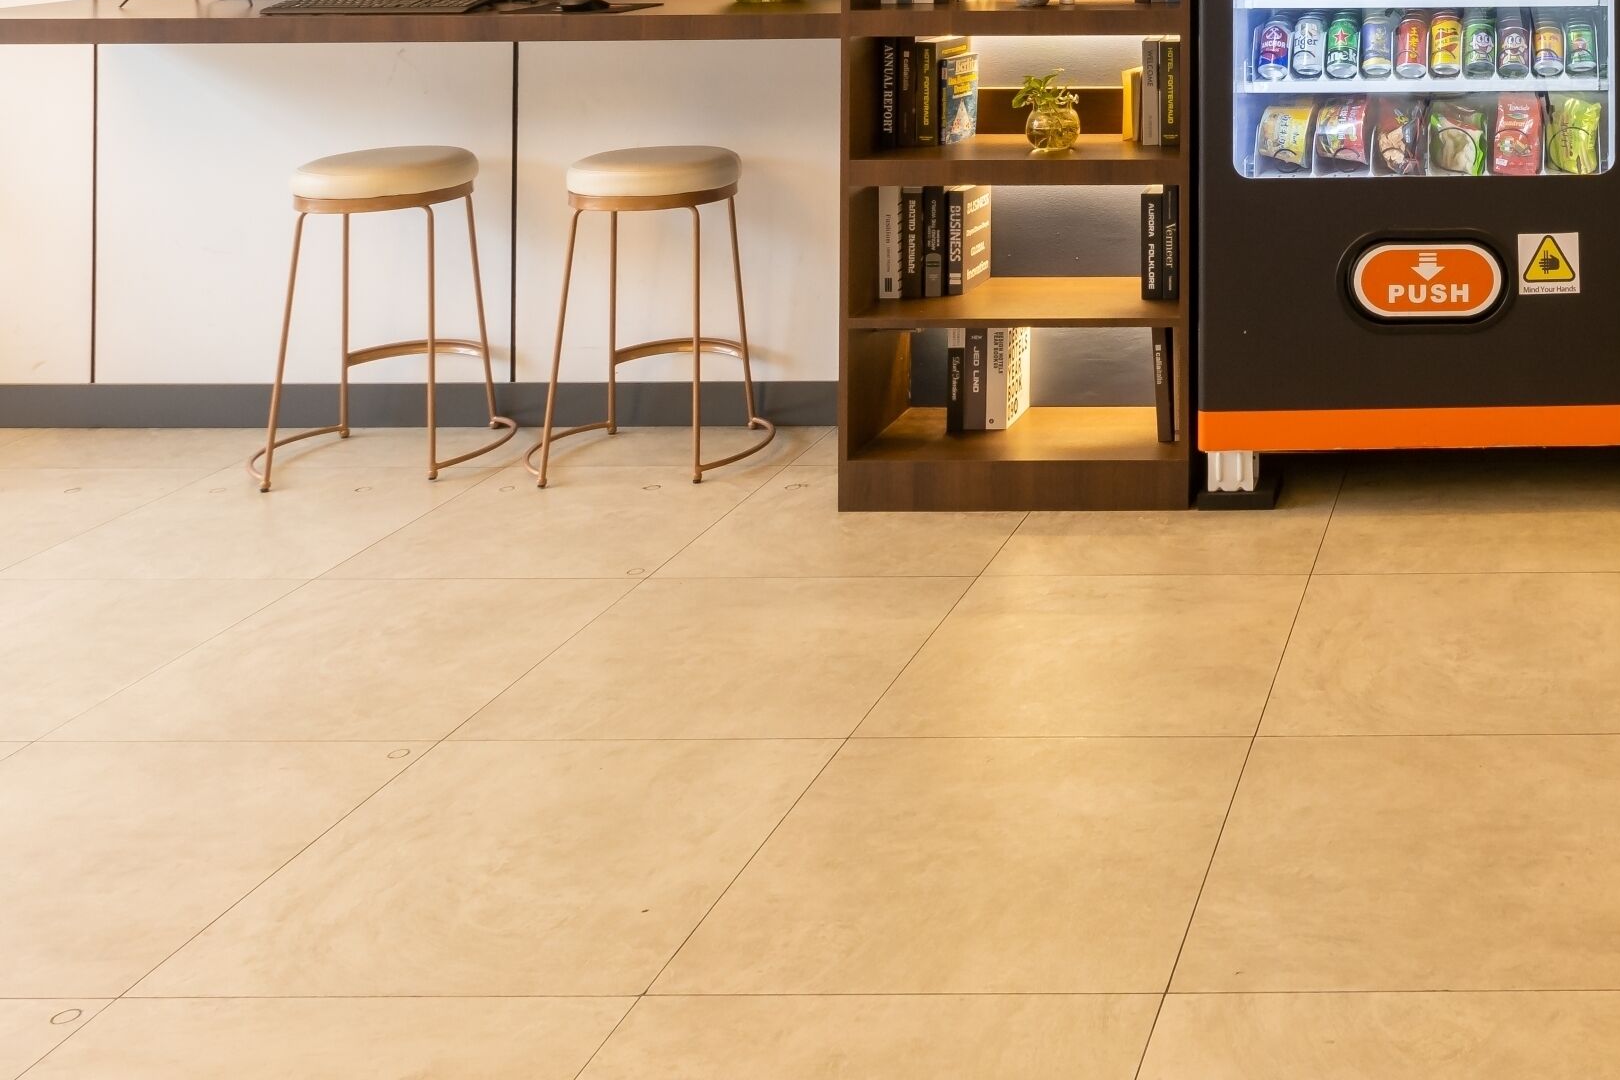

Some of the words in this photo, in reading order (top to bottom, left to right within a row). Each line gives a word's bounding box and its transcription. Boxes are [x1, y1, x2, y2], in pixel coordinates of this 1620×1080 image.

[884, 45, 893, 88] ANNUAL
[883, 91, 893, 134] REPORT
[950, 206, 961, 262] BUSINESS
[1165, 223, 1176, 268] Vermeer
[1388, 283, 1469, 304] PUSH
